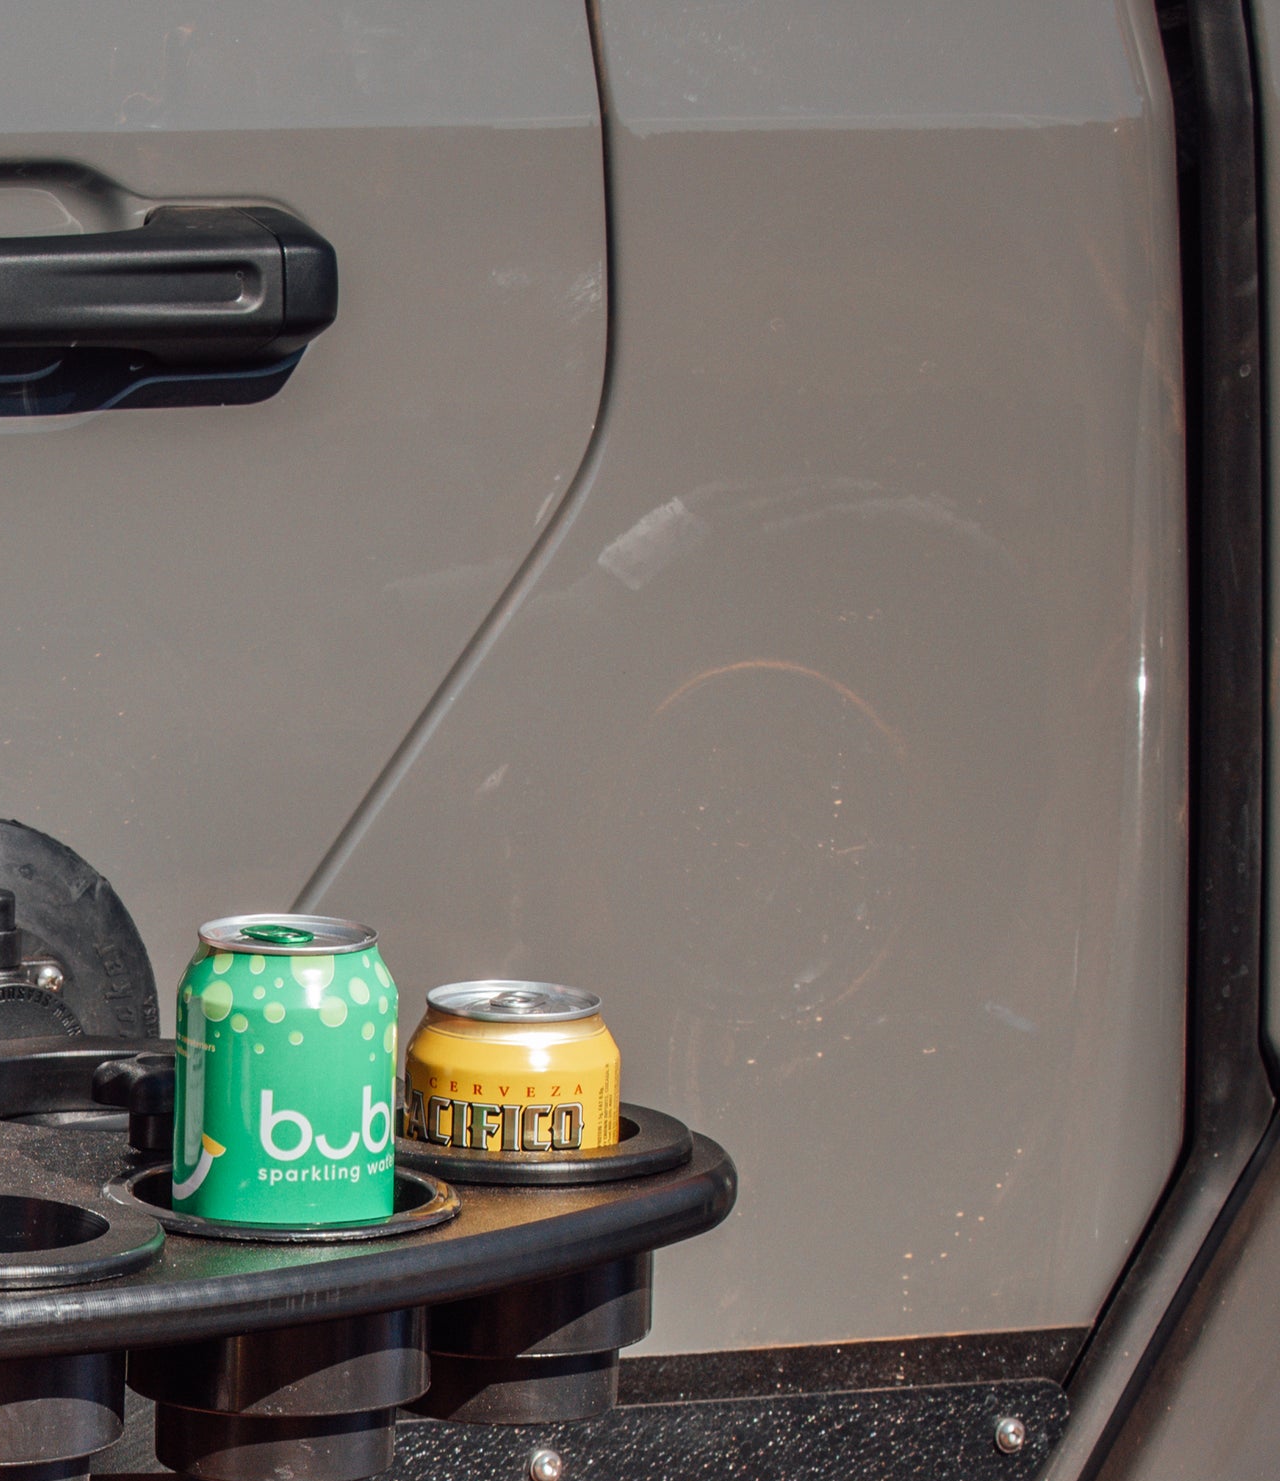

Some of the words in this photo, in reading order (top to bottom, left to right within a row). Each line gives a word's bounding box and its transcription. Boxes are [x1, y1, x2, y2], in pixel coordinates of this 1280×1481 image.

[428, 1077, 583, 1099] CERVEZA
[260, 1076, 397, 1162] bubl
[258, 1164, 361, 1187] sparkling
[367, 1153, 396, 1176] wate
